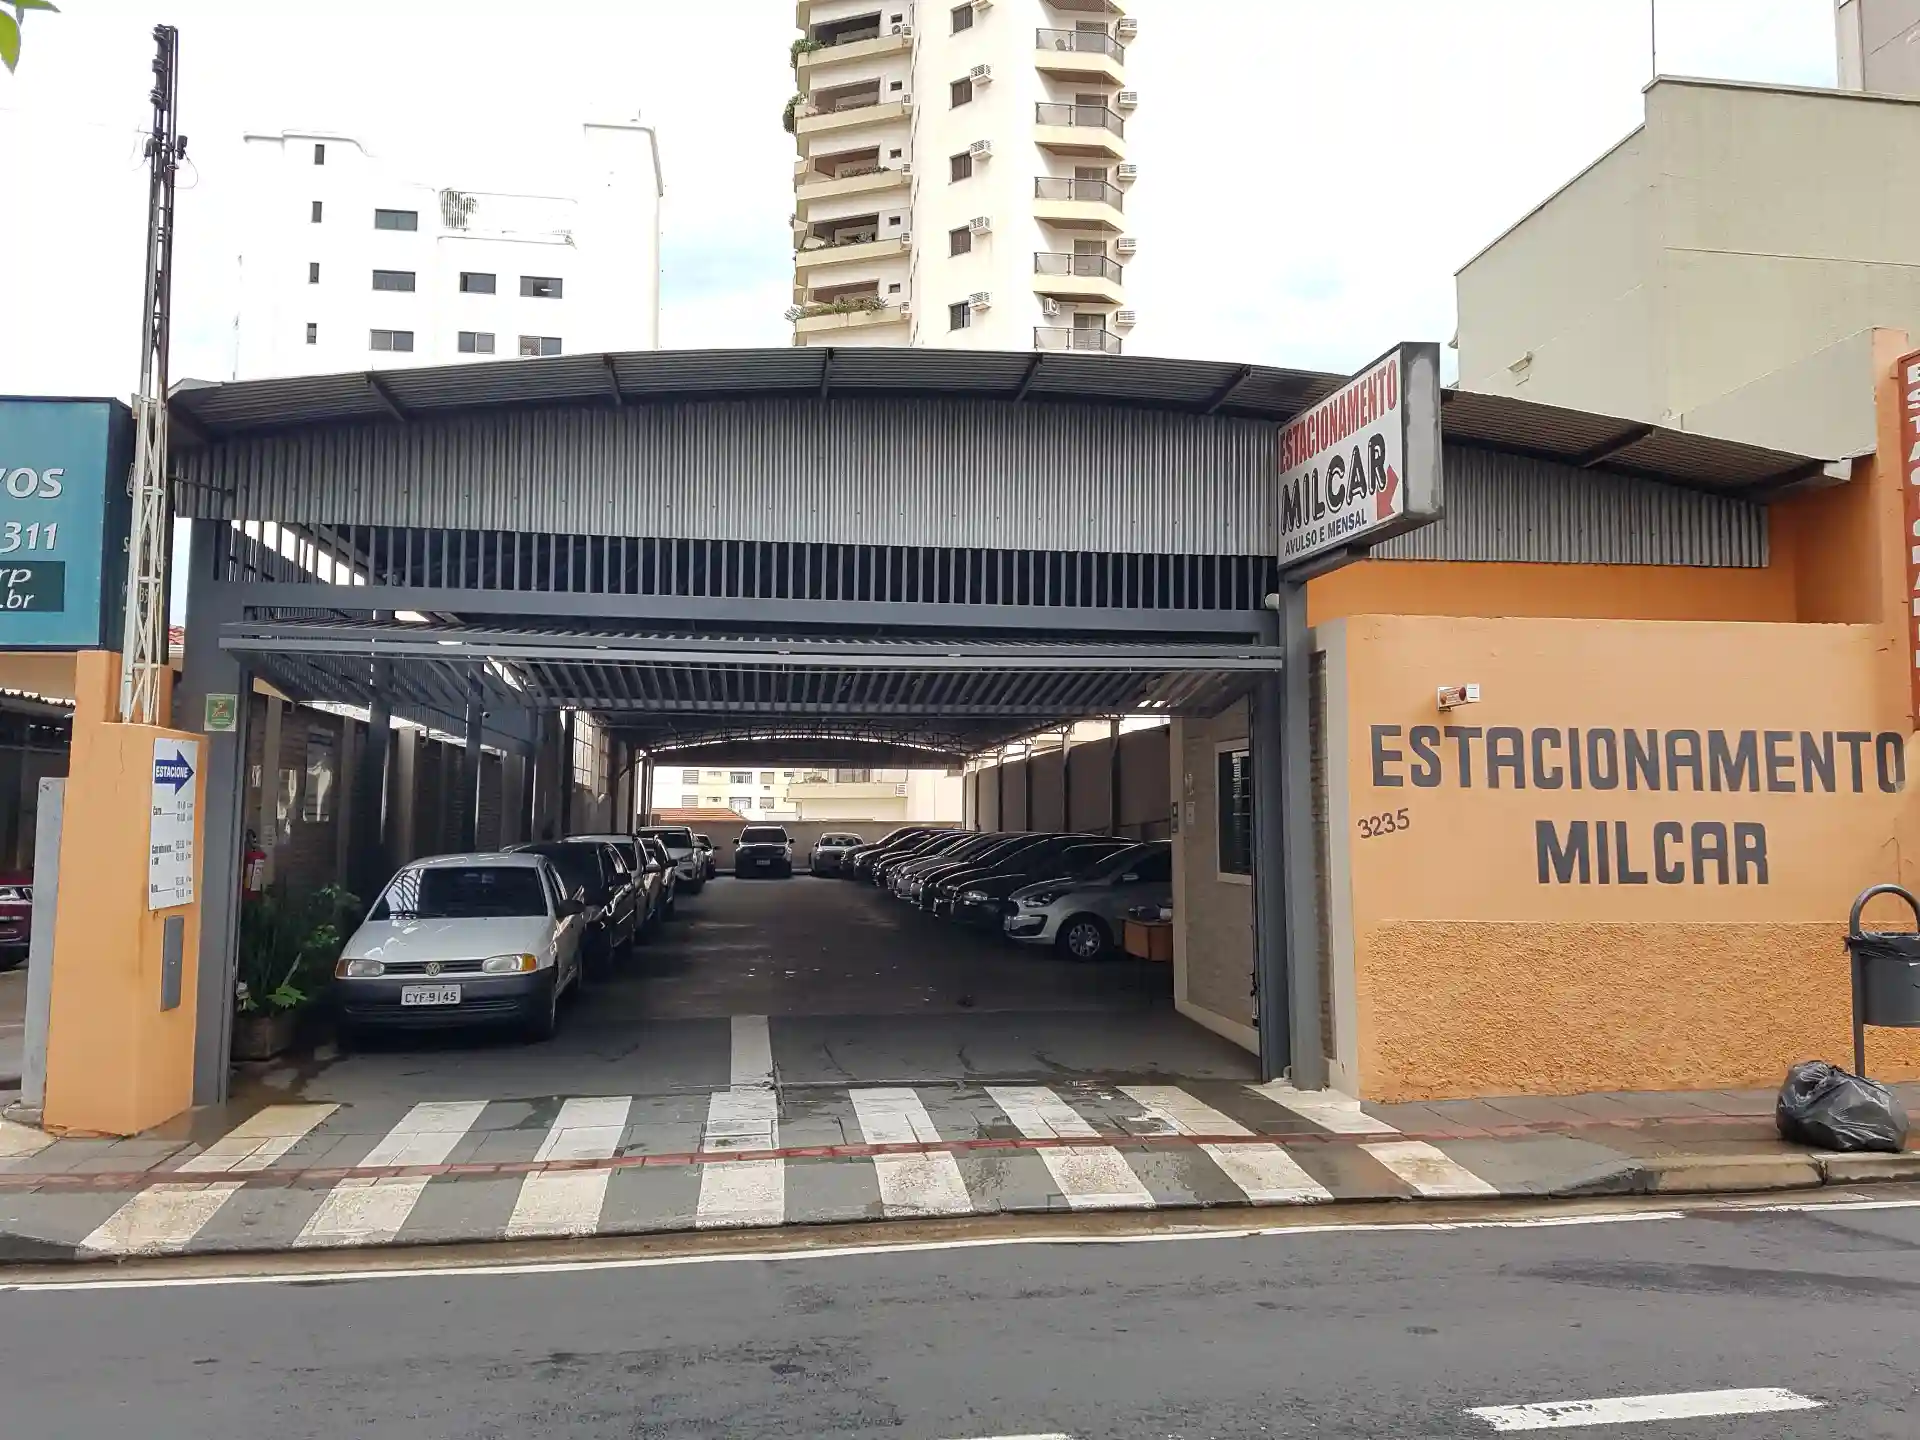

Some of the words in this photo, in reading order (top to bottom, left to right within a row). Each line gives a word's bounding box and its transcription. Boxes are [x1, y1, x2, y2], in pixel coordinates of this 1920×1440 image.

[1280, 359, 1397, 475] ESTACIONAMENTO
[1281, 433, 1387, 536] MILCAR
[1285, 528, 1317, 557] AVULSO
[1319, 526, 1326, 542] E
[1328, 508, 1368, 539] MENSAL
[155, 765, 189, 779] ESTACIONE
[1370, 724, 1906, 794] ESTACIONAMENTO
[1357, 807, 1410, 839] 3235
[1534, 820, 1769, 885] MILCAR
